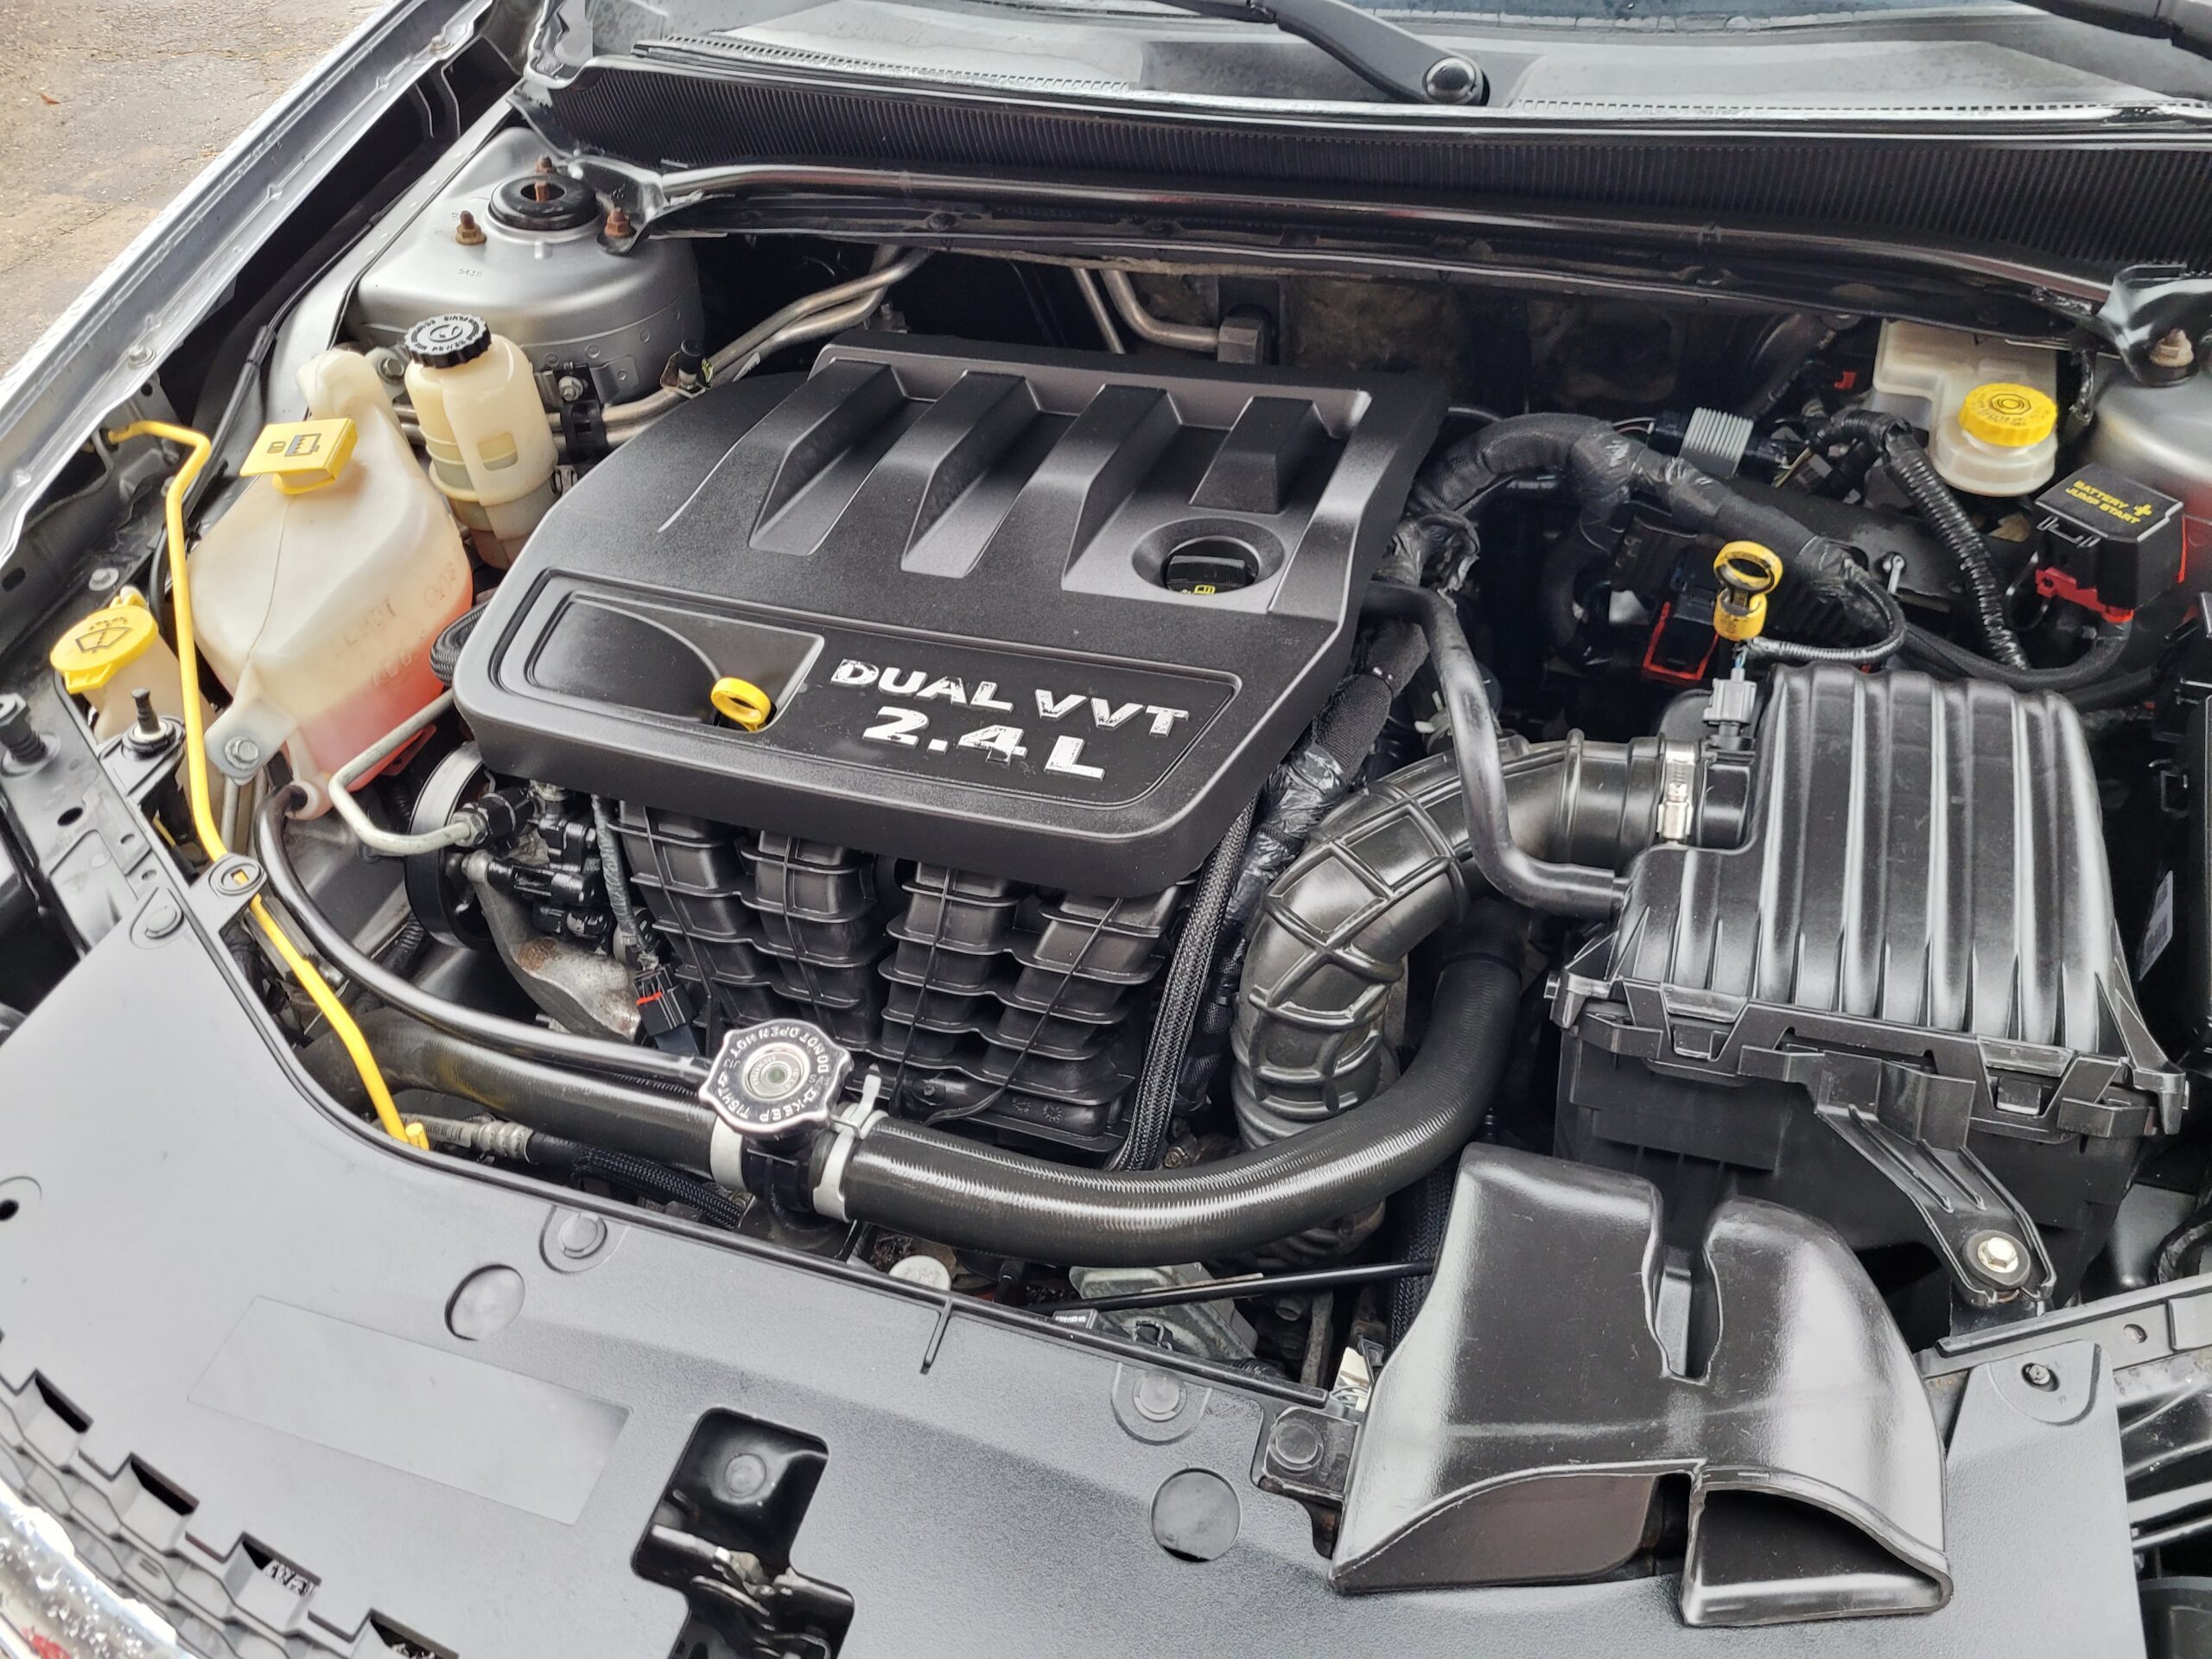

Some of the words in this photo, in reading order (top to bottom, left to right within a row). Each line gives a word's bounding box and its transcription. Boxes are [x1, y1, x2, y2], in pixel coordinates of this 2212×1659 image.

[2065, 487, 2100, 505] JUMP
[2099, 504, 2140, 524] START
[2074, 480, 2129, 509] BATTERY
[830, 658, 1014, 713] DUAL
[1035, 689, 1189, 737] VVT
[729, 1033, 757, 1058] HOT
[759, 1027, 801, 1040] OPEN
[717, 1087, 750, 1120] TIGHT
[760, 1098, 804, 1122] KEEP
